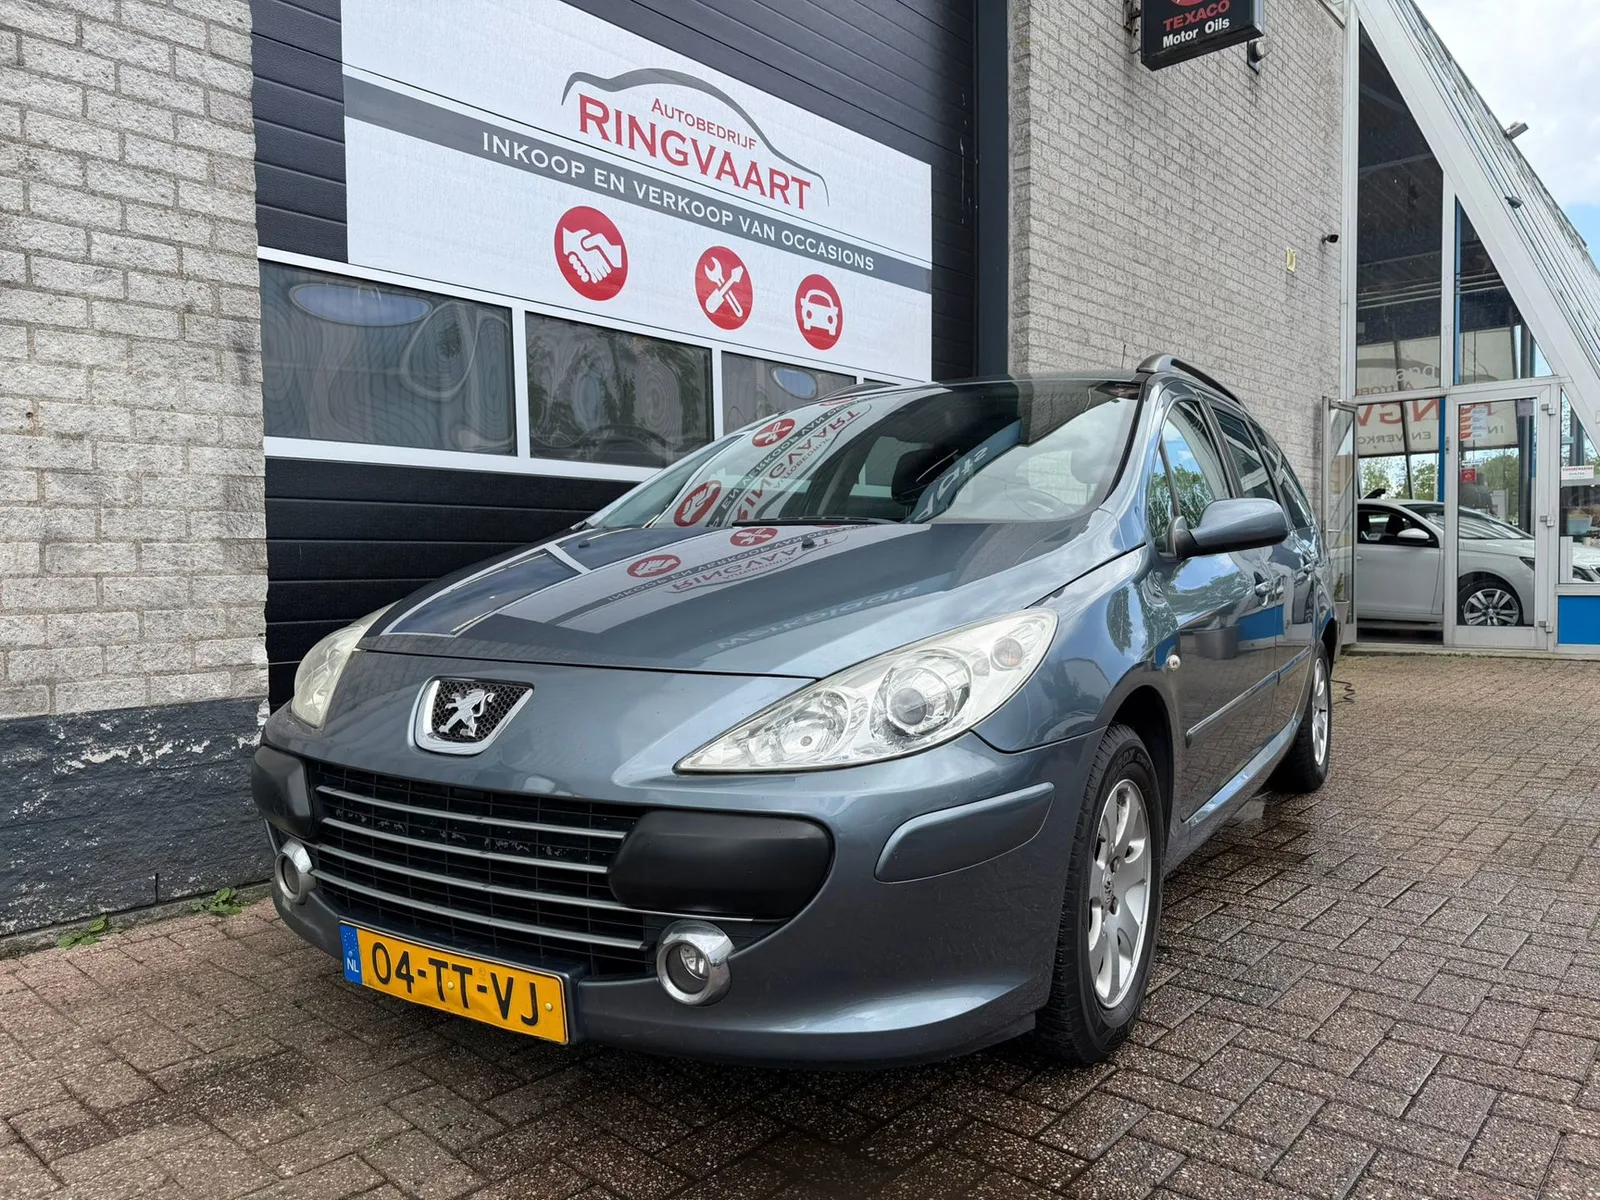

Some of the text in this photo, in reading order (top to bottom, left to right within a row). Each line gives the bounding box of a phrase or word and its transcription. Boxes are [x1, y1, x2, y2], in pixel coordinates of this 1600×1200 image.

[1162, 17, 1230, 49] Motor Oils
[1163, 0, 1231, 32] TEXACO
[651, 98, 757, 150] AUTOBEDRIJF
[579, 93, 811, 210] RINGVAART
[482, 131, 874, 271] INKOOP EN VERKOOP VAN OCCASIONS
[346, 957, 360, 973] NL
[371, 942, 539, 1026] 04-TT-VJ
